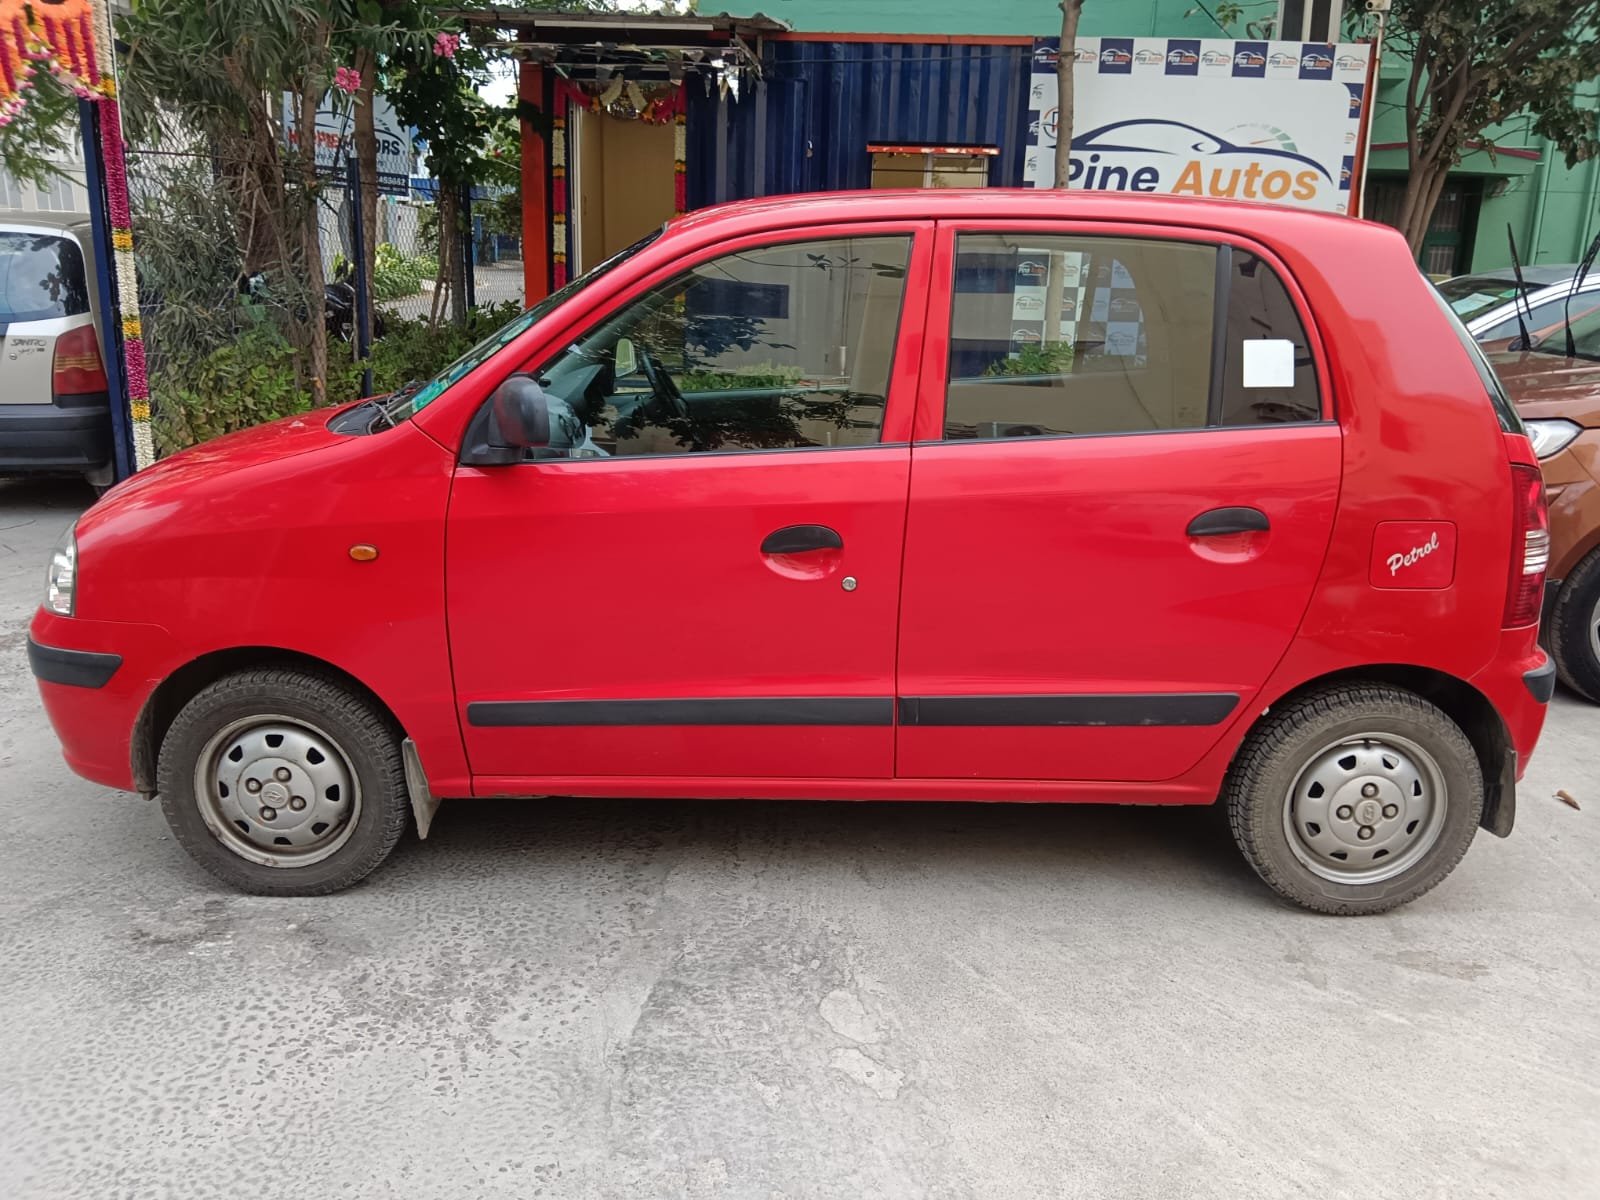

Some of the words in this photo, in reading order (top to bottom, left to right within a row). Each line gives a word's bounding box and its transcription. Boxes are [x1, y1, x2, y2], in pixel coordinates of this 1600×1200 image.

[287, 127, 339, 148] HPPIE
[1068, 154, 1159, 191] Pine
[1171, 160, 1319, 200] Autos
[1387, 531, 1439, 576] Petrol
